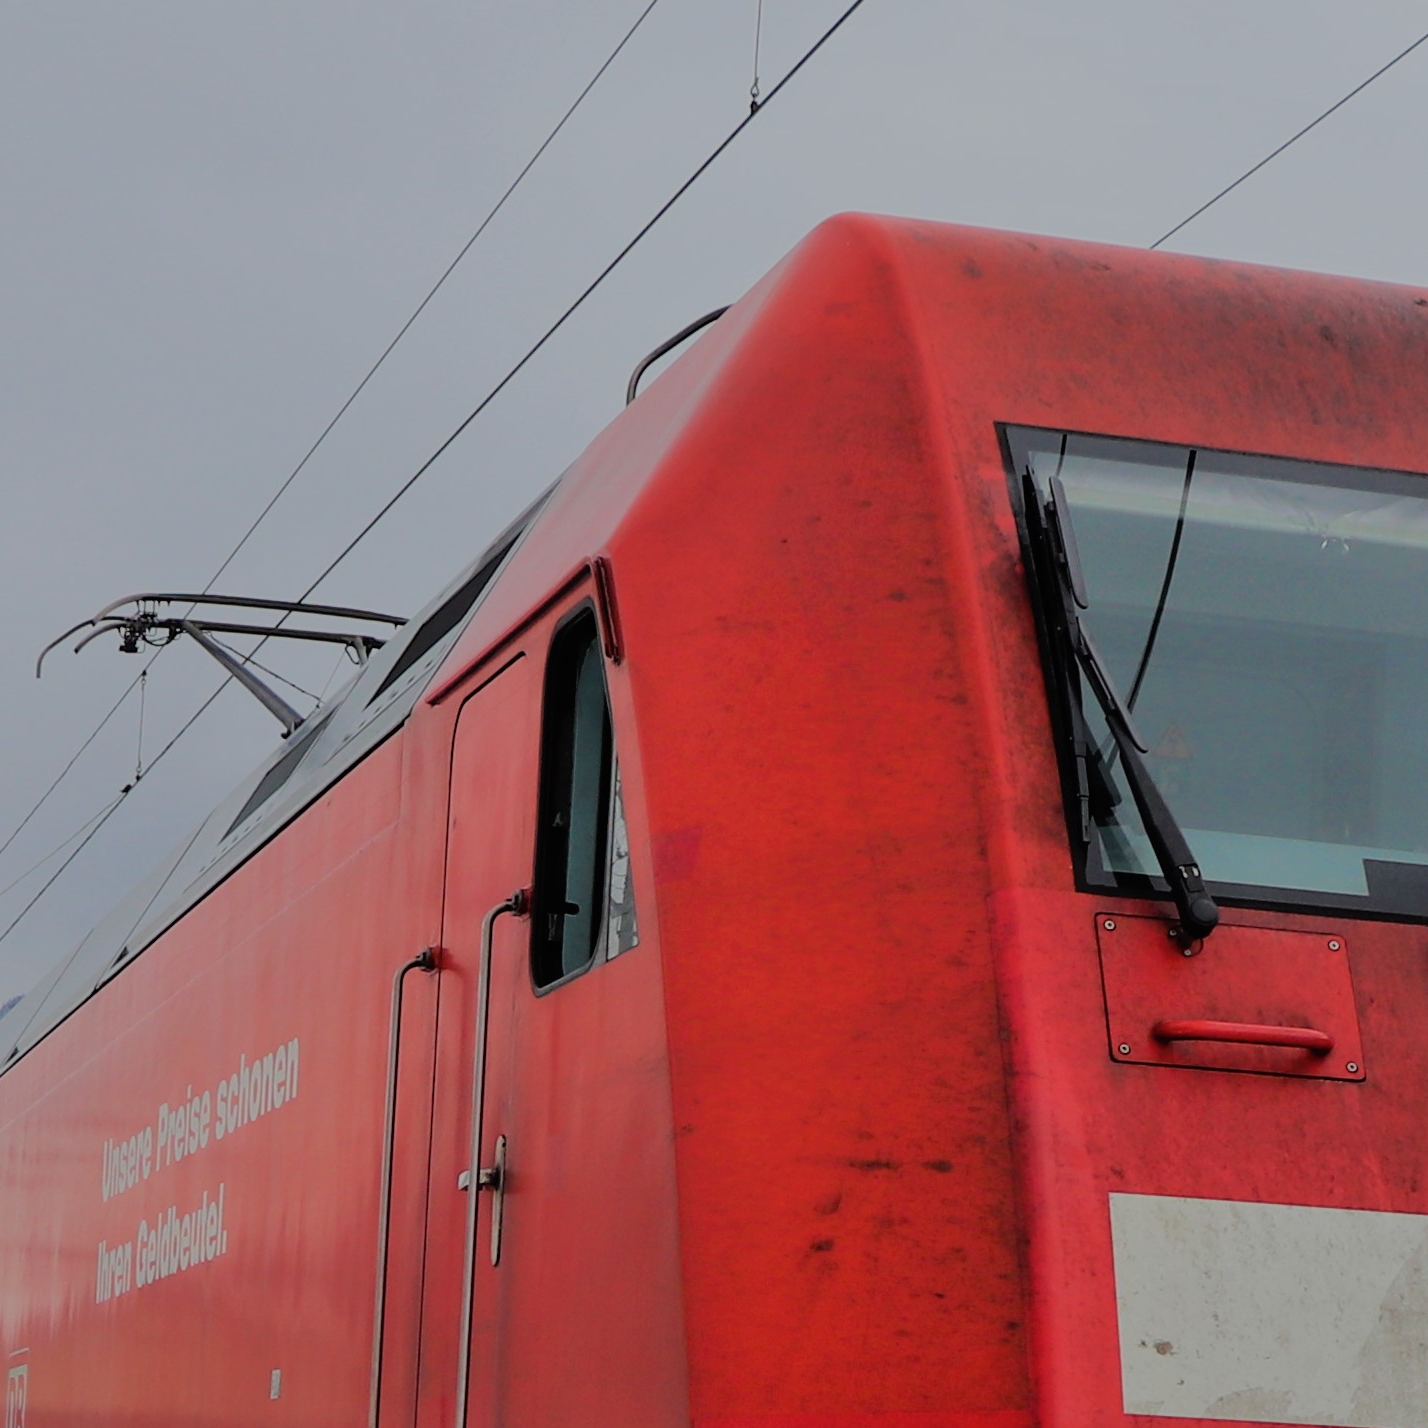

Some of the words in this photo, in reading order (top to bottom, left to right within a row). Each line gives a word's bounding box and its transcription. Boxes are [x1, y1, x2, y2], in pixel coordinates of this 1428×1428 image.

[102, 1126, 152, 1203] Unsere
[155, 1083, 211, 1172] Preise
[215, 1037, 300, 1140] schonen
[95, 1239, 132, 1305] Ihren
[135, 1182, 228, 1289] Geldbeutel.
